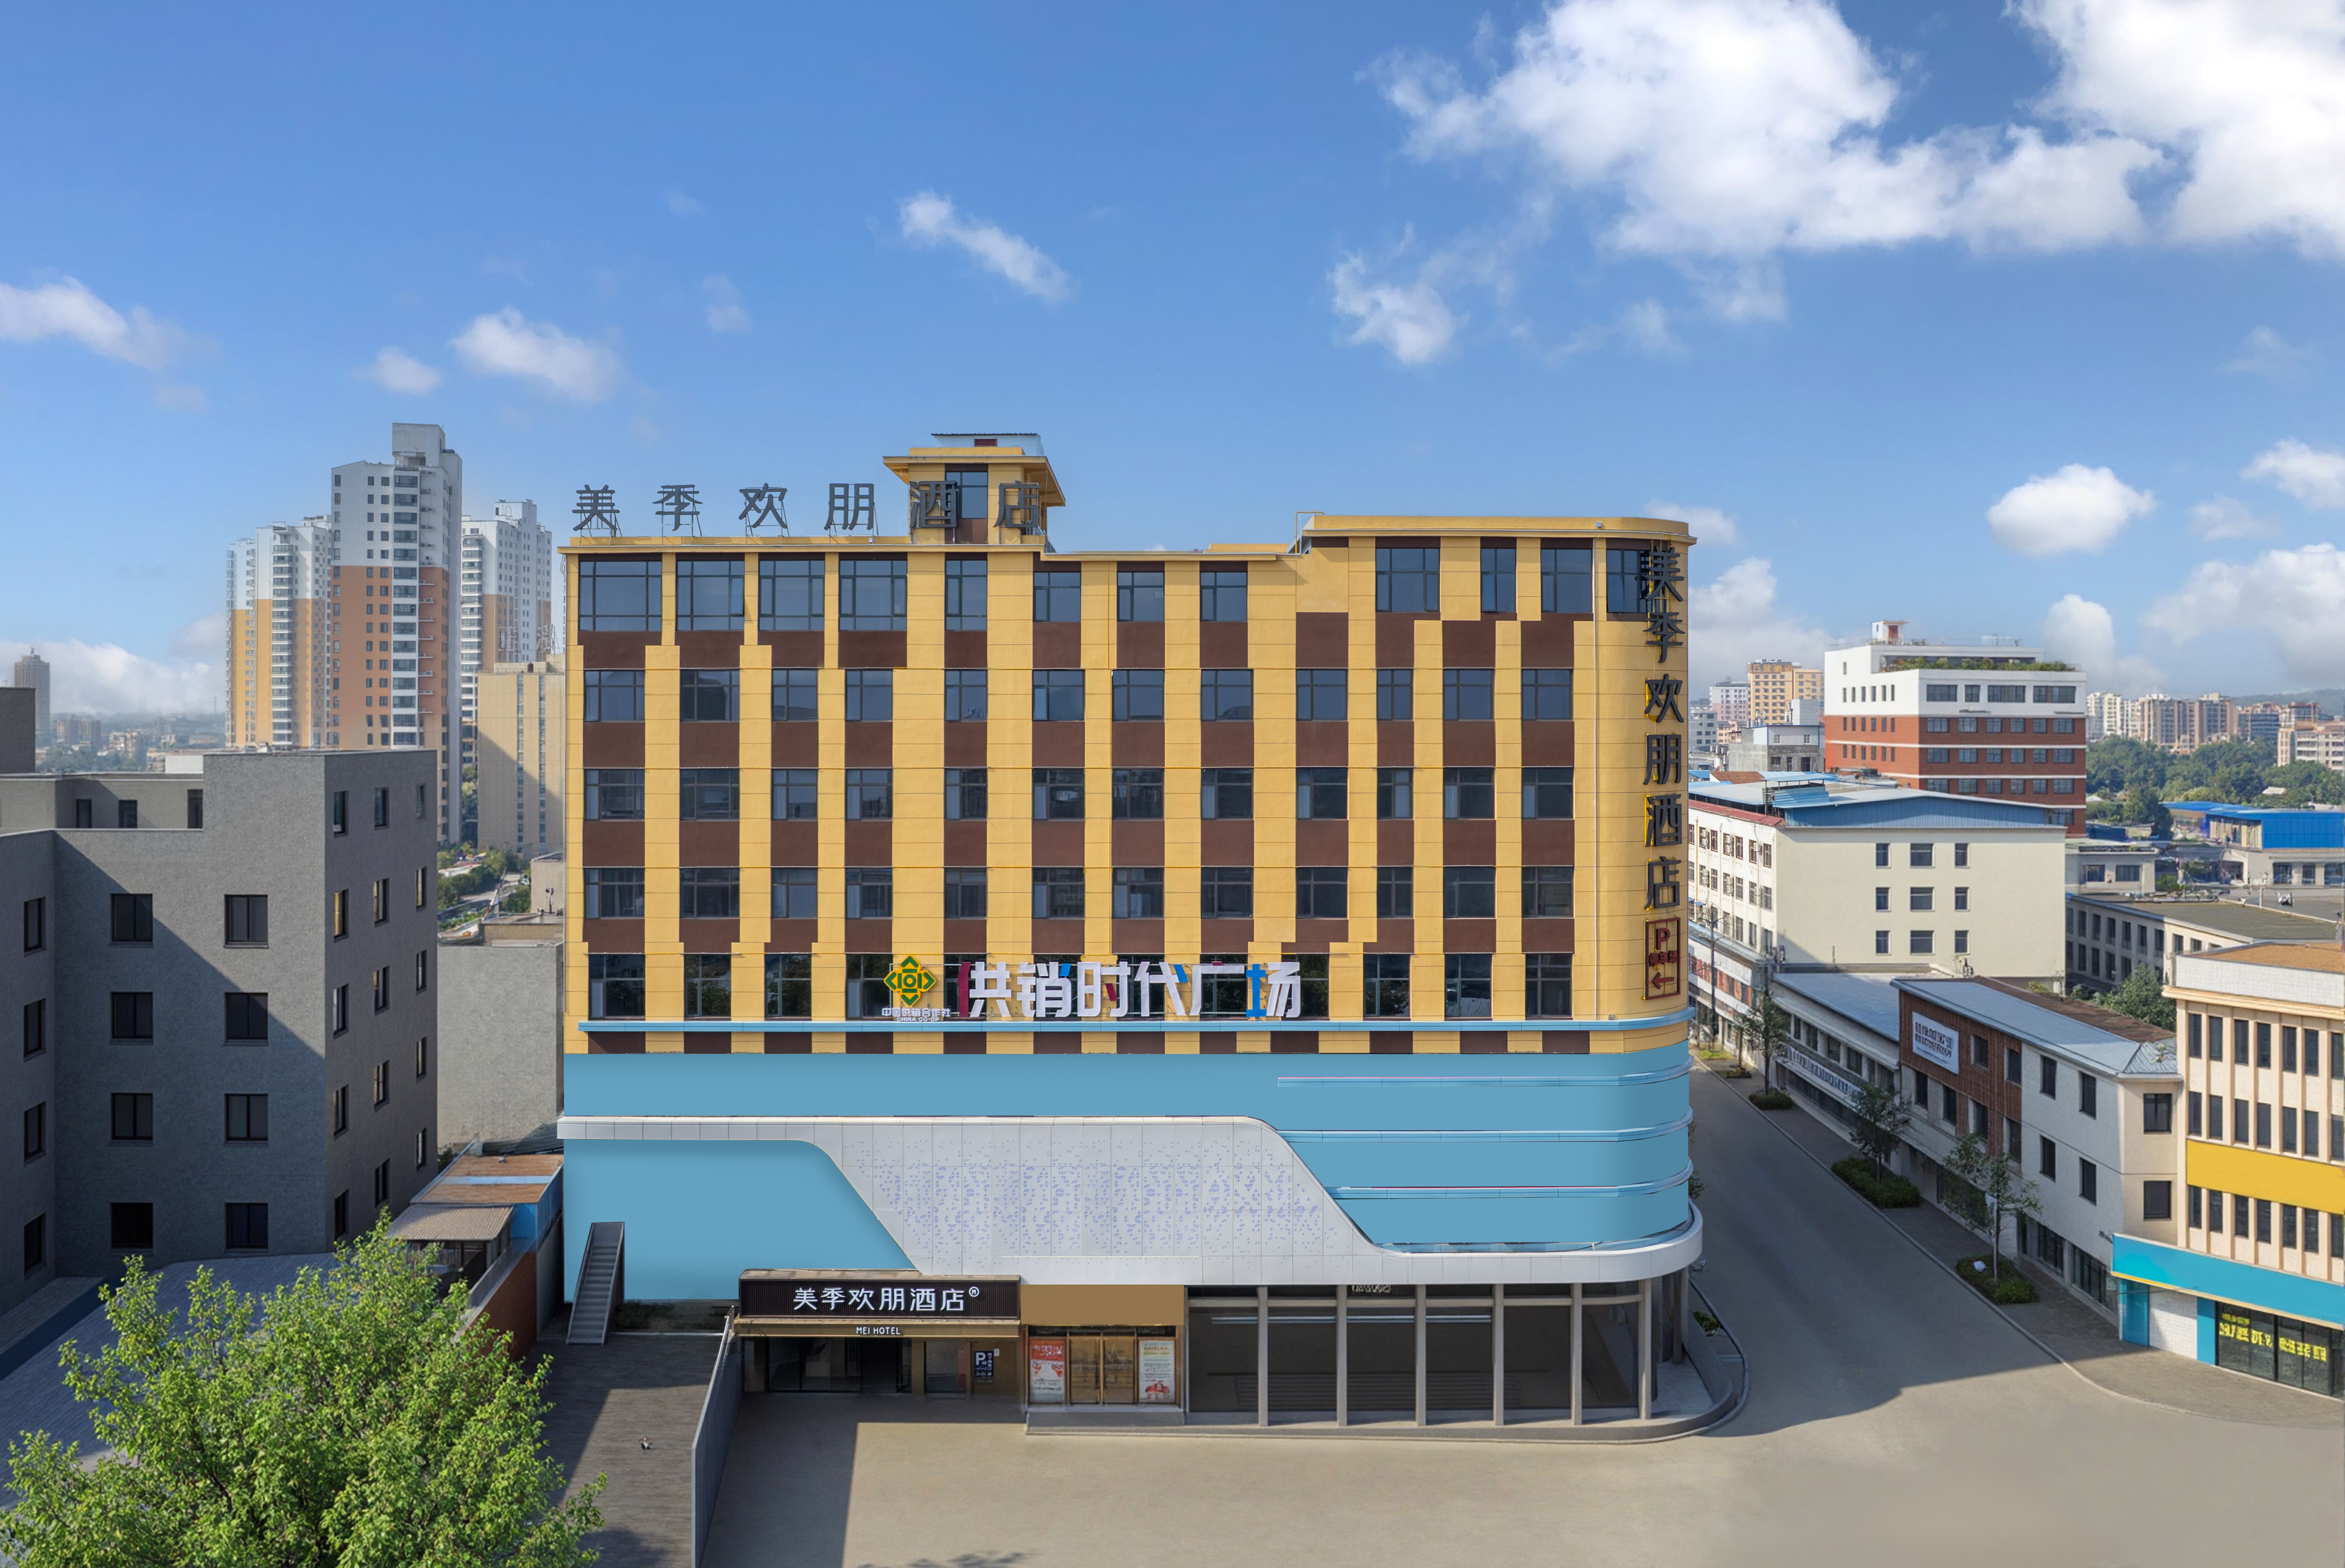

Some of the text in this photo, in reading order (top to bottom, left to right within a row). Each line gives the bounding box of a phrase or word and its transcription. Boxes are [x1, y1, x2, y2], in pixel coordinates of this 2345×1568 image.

[572, 480, 1041, 532] 美季欢朋酒店
[1643, 545, 1685, 910] 美季欢朋酒店
[1656, 928, 1671, 950] P
[1648, 950, 1678, 967] 停车场
[957, 961, 1301, 1018] 供销时代广场
[882, 1007, 951, 1017] 中国供销合作社
[793, 1287, 965, 1312] 美季欢朋酒店
[856, 1326, 901, 1335] MEI HOTEL
[975, 1352, 986, 1365] P
